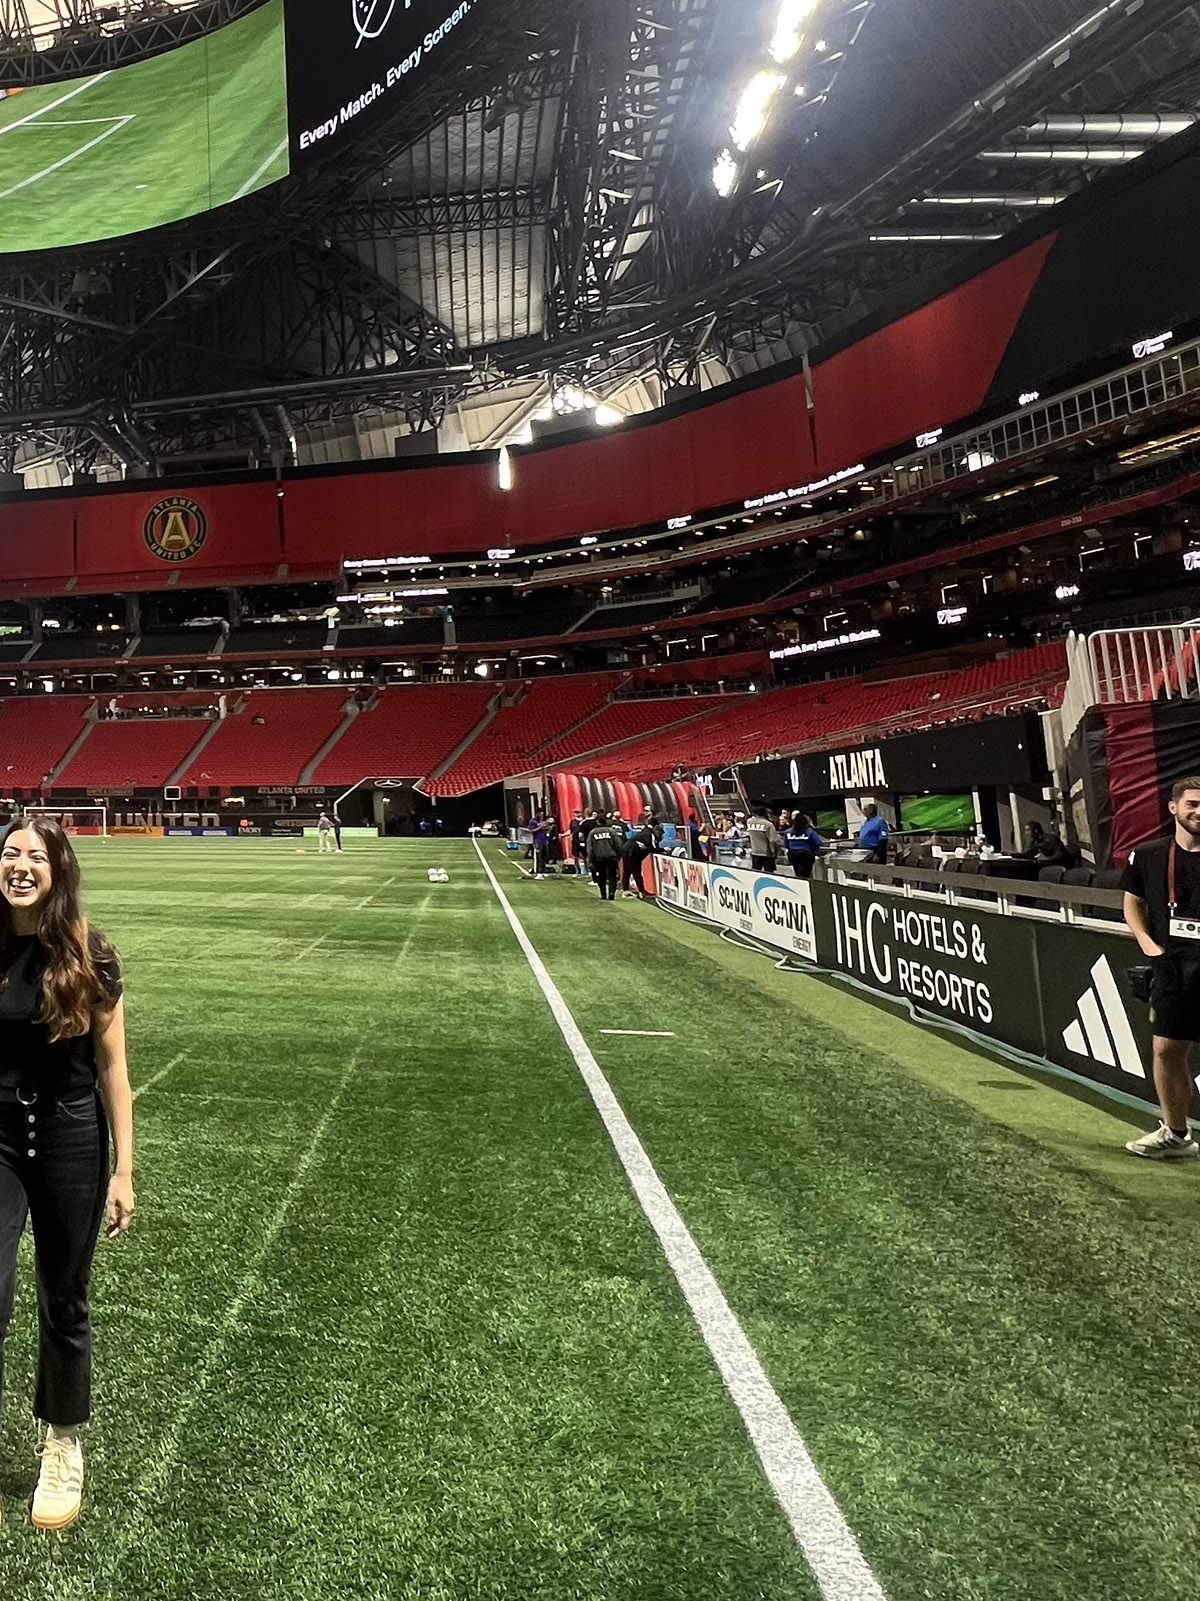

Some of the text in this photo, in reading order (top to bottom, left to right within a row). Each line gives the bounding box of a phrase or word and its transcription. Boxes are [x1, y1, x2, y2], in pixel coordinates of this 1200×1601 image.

[300, 1, 471, 149] Every Match. Every Screen.
[153, 498, 198, 515] ATLANTA
[829, 749, 886, 790] ATLANTA
[115, 812, 220, 827] UNITED
[719, 885, 752, 917] SCANA
[764, 897, 810, 935] SCANA
[832, 893, 892, 984] IHG
[893, 908, 987, 965] HOTELS &
[897, 957, 993, 1024] RESORTS
